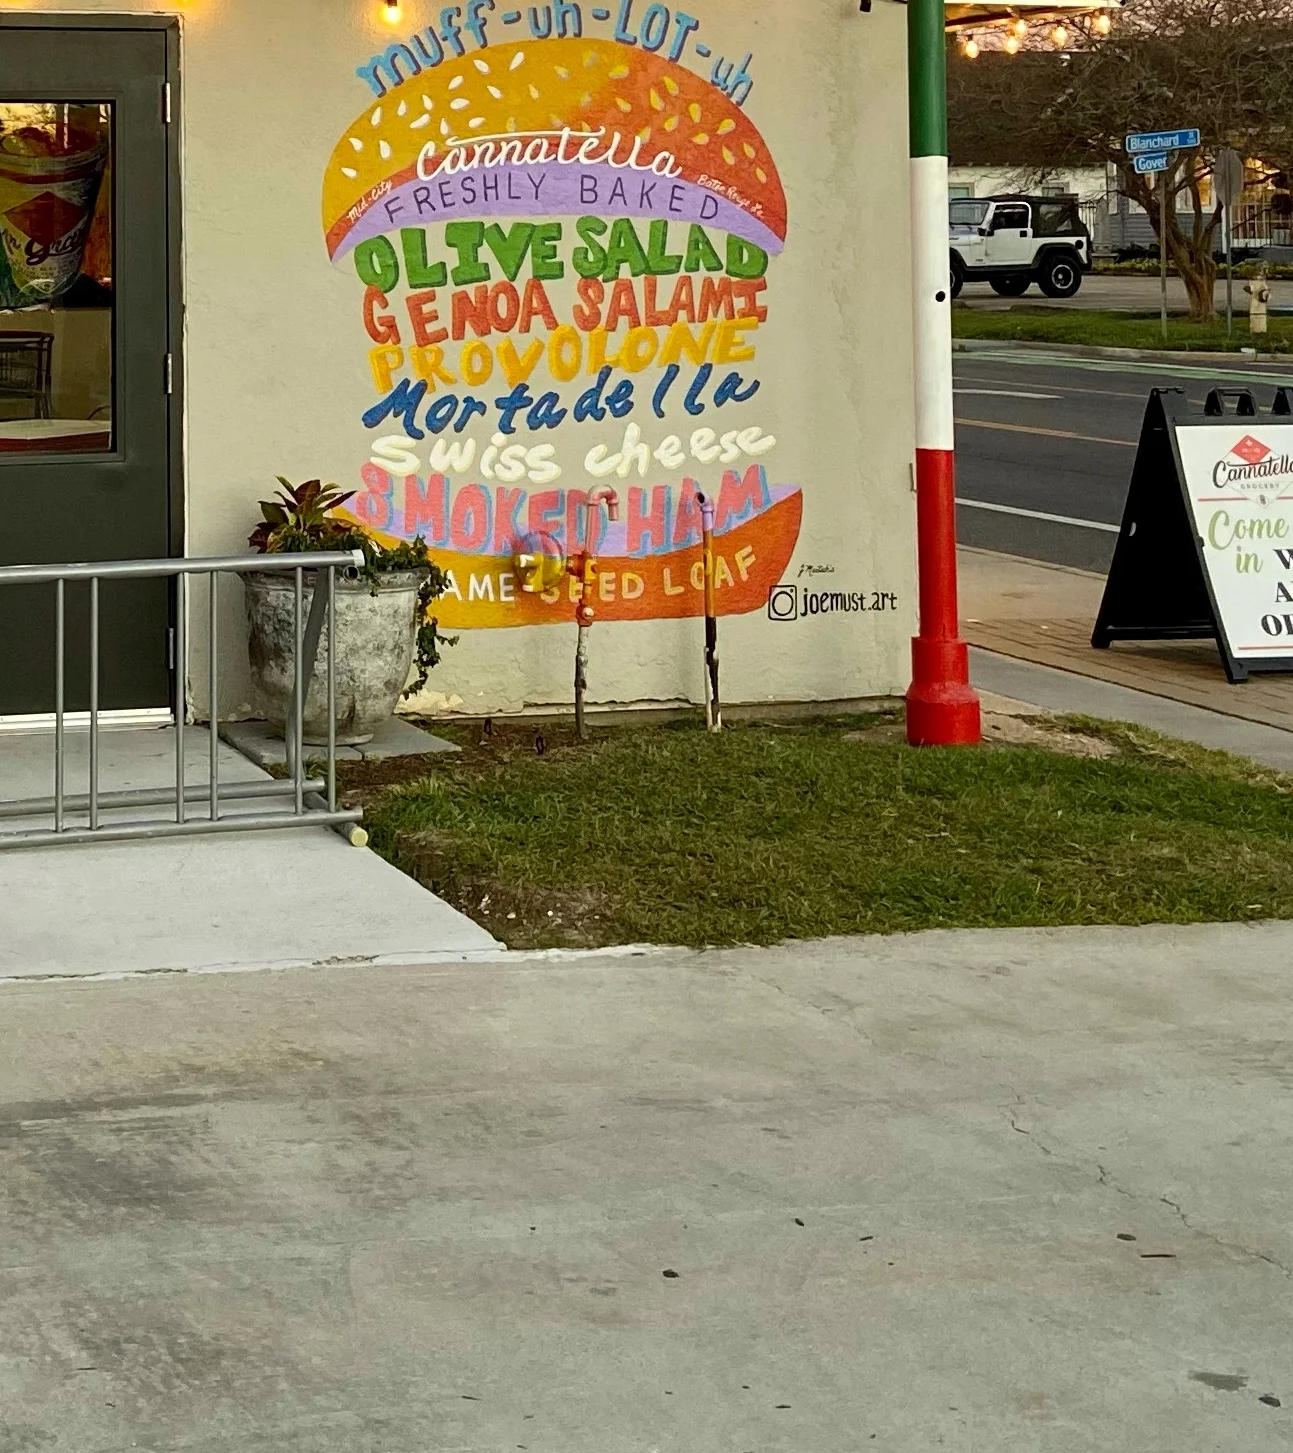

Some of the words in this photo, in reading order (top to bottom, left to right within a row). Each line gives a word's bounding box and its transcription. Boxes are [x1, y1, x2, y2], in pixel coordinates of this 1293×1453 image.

[416, 125, 683, 182] Cannatella
[1130, 133, 1180, 150] Blanchard
[383, 171, 546, 224] FRESHLY
[579, 173, 719, 220] BAKED
[354, 221, 565, 293] OLIVE
[572, 215, 769, 283] SALAD
[363, 278, 559, 347] GENOA
[572, 275, 768, 331] SALAMI
[367, 316, 759, 394] PROVOLONE
[361, 362, 761, 440] Mortadella
[584, 422, 776, 478] cheese
[625, 463, 772, 559] HAM
[1240, 482, 1280, 490] GROCERY
[1208, 510, 1289, 550] Come
[662, 544, 757, 596] LOAF
[1235, 545, 1264, 574] in
[799, 587, 898, 617] joemust.art
